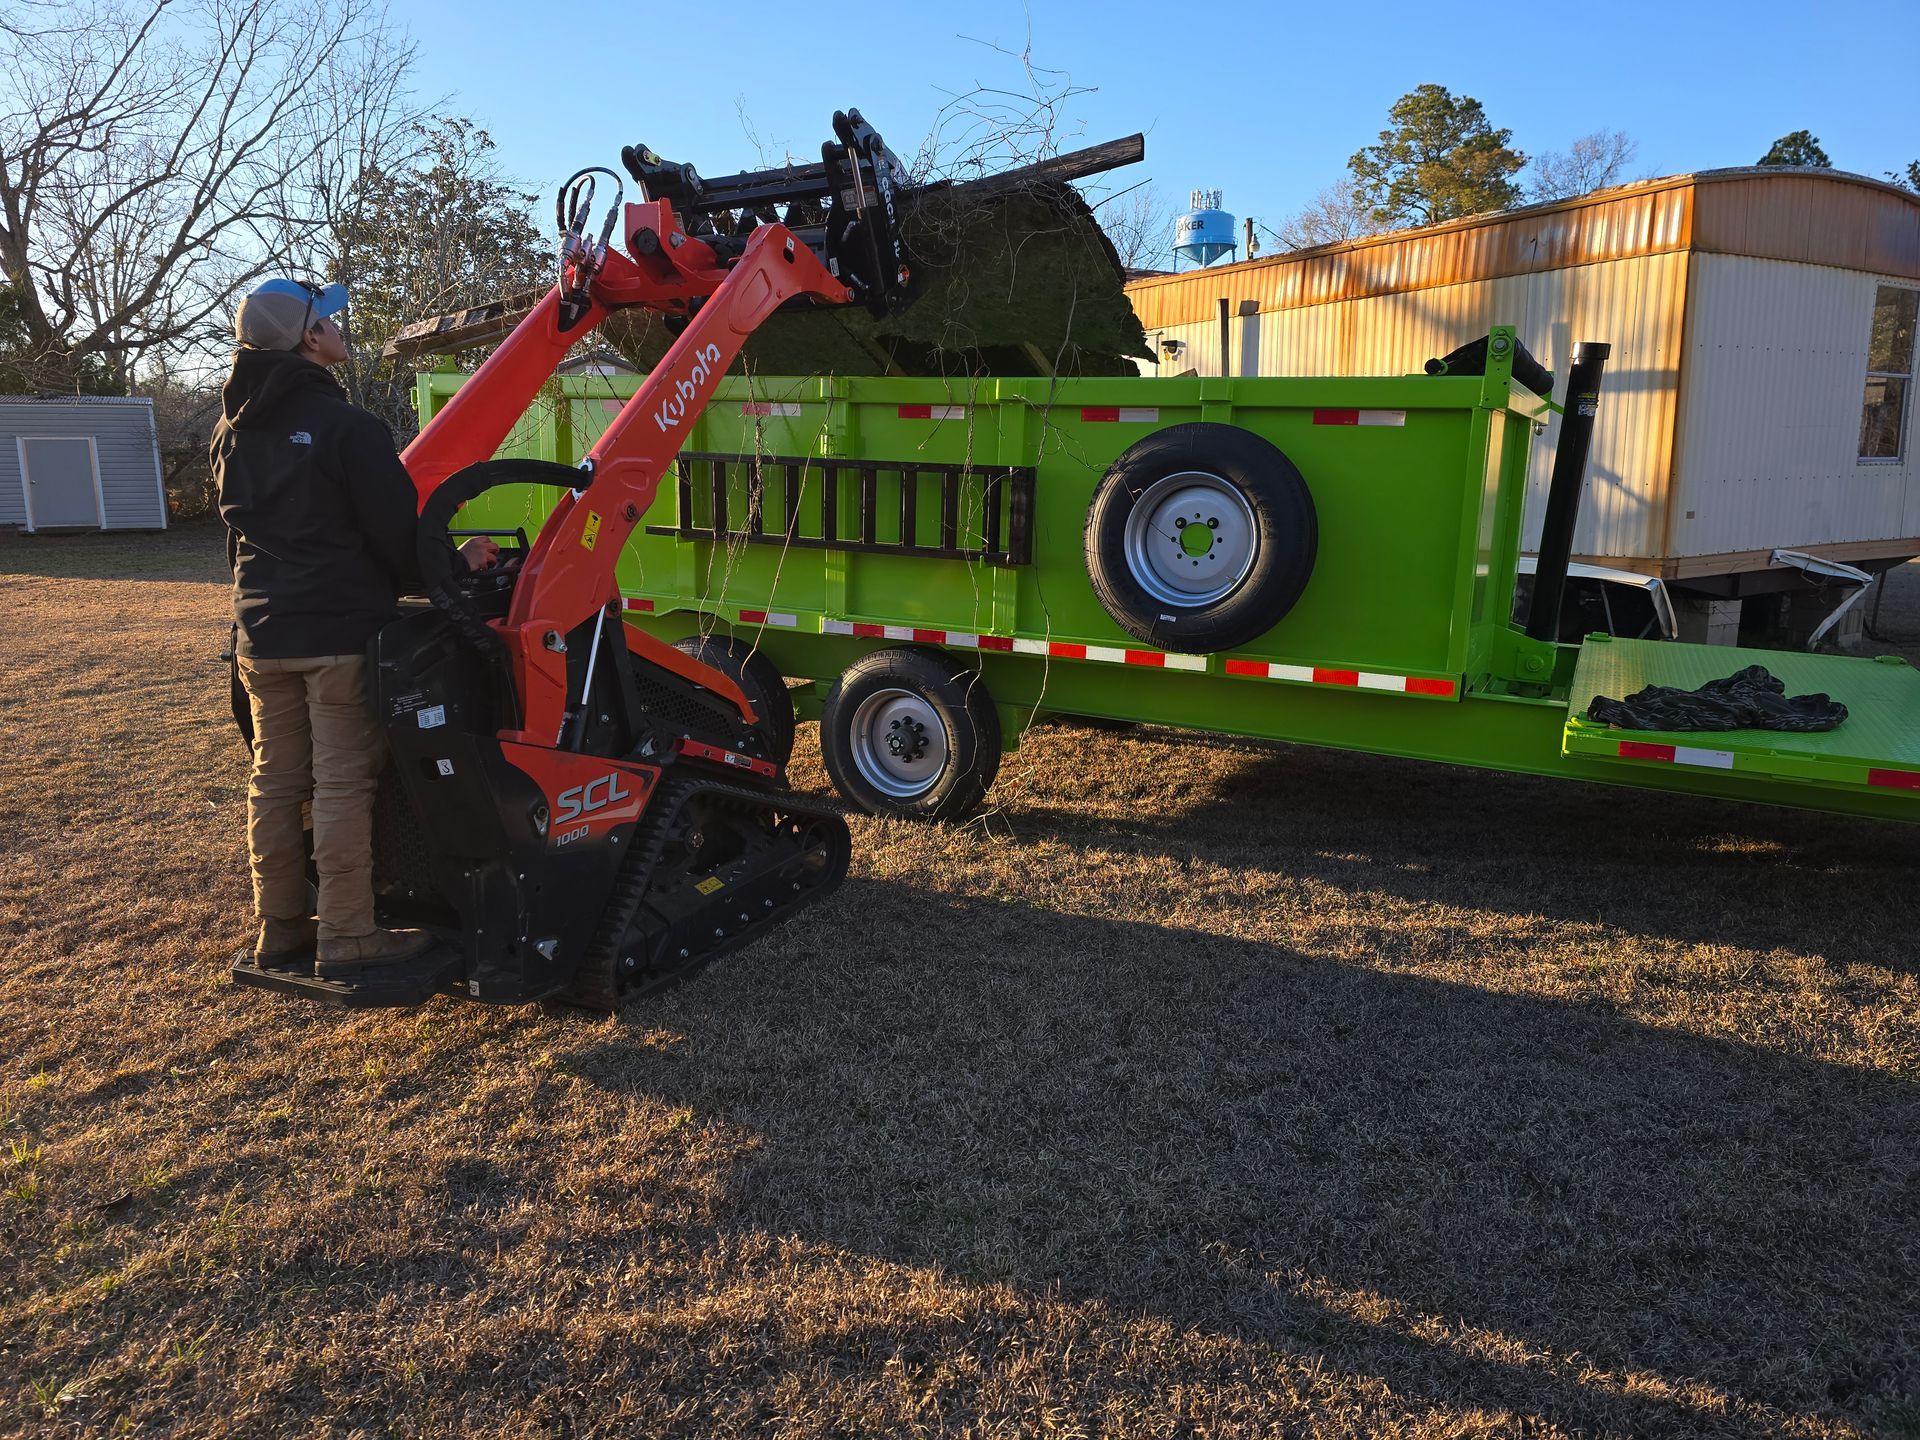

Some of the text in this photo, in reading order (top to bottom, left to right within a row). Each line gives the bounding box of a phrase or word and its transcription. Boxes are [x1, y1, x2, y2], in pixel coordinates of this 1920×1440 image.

[654, 343, 721, 433] Kubota
[555, 772, 629, 824] SCL
[556, 824, 590, 848] 1000
